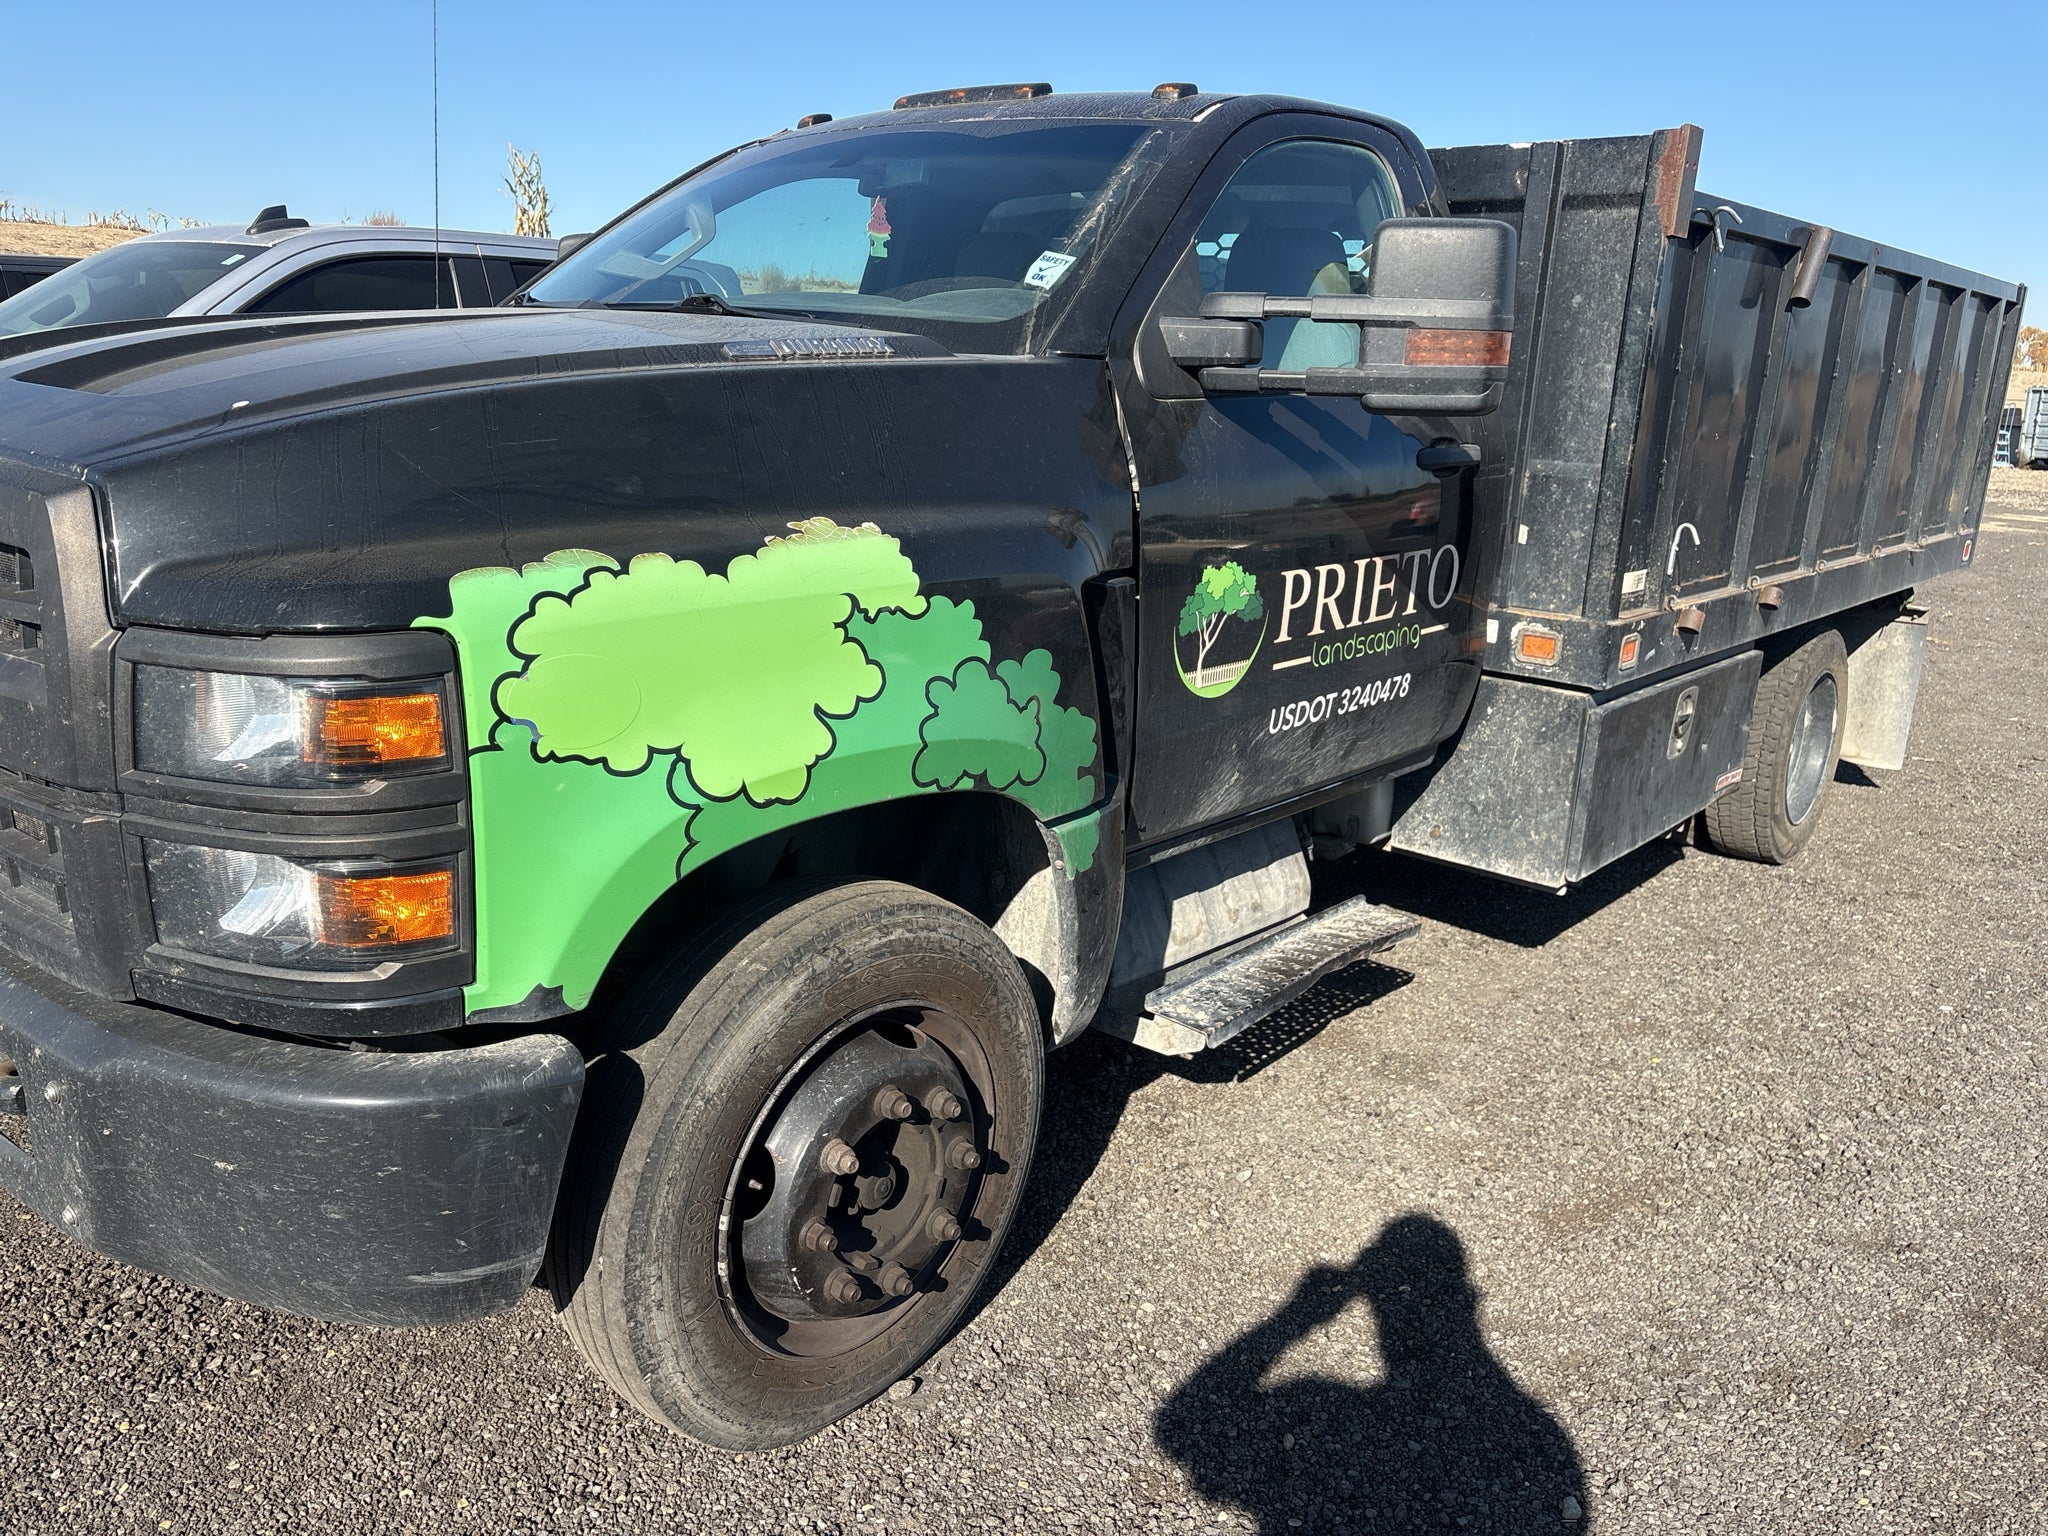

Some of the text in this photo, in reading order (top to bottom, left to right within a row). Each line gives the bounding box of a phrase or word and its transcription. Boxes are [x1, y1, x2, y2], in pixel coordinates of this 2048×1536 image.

[1031, 272, 1047, 282] OK
[1039, 254, 1071, 266] SAFETY
[1273, 544, 1459, 643] PRIETO
[1311, 623, 1421, 667] landscaping
[1268, 673, 1412, 735] USDOT 3240478
